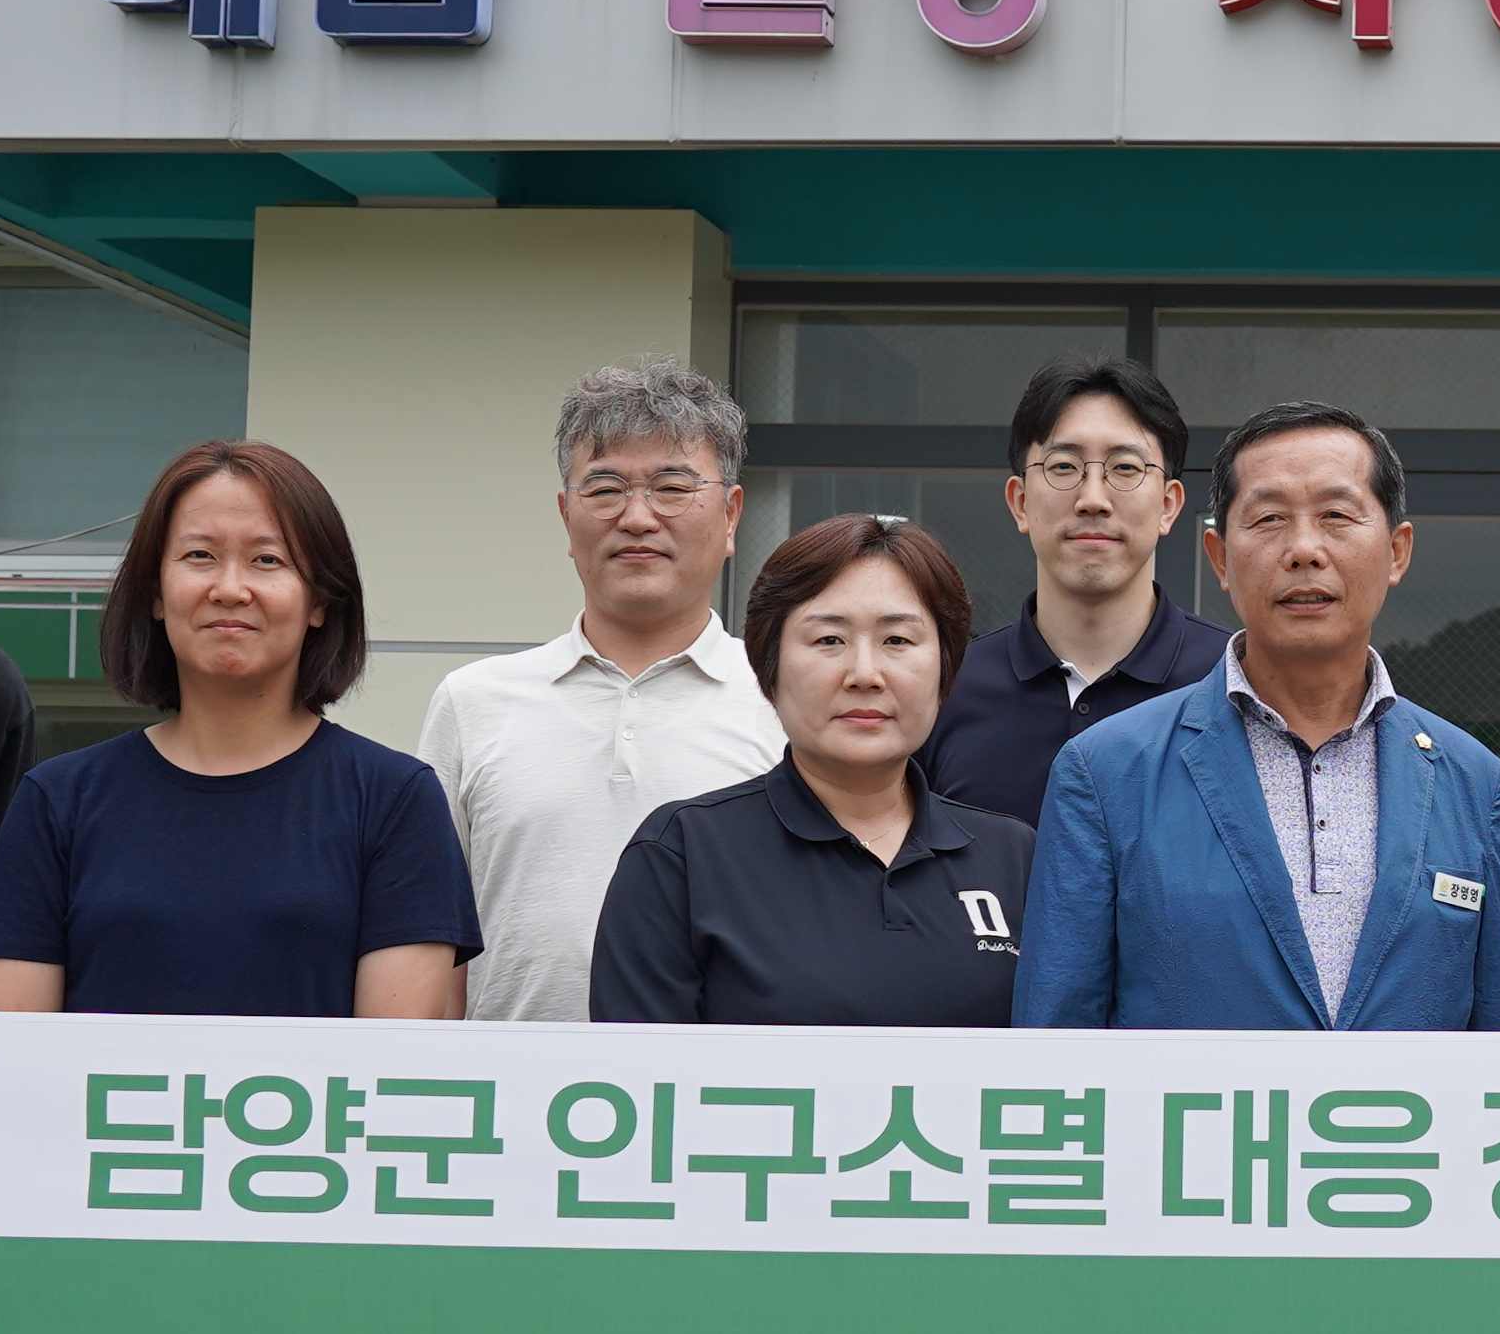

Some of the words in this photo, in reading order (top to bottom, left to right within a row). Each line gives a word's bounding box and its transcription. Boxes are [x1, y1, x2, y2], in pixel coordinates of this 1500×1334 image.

[87, 1074, 504, 1217] 담양군
[545, 1081, 1106, 1226] 인구소멸
[1162, 1090, 1440, 1229] 대응
